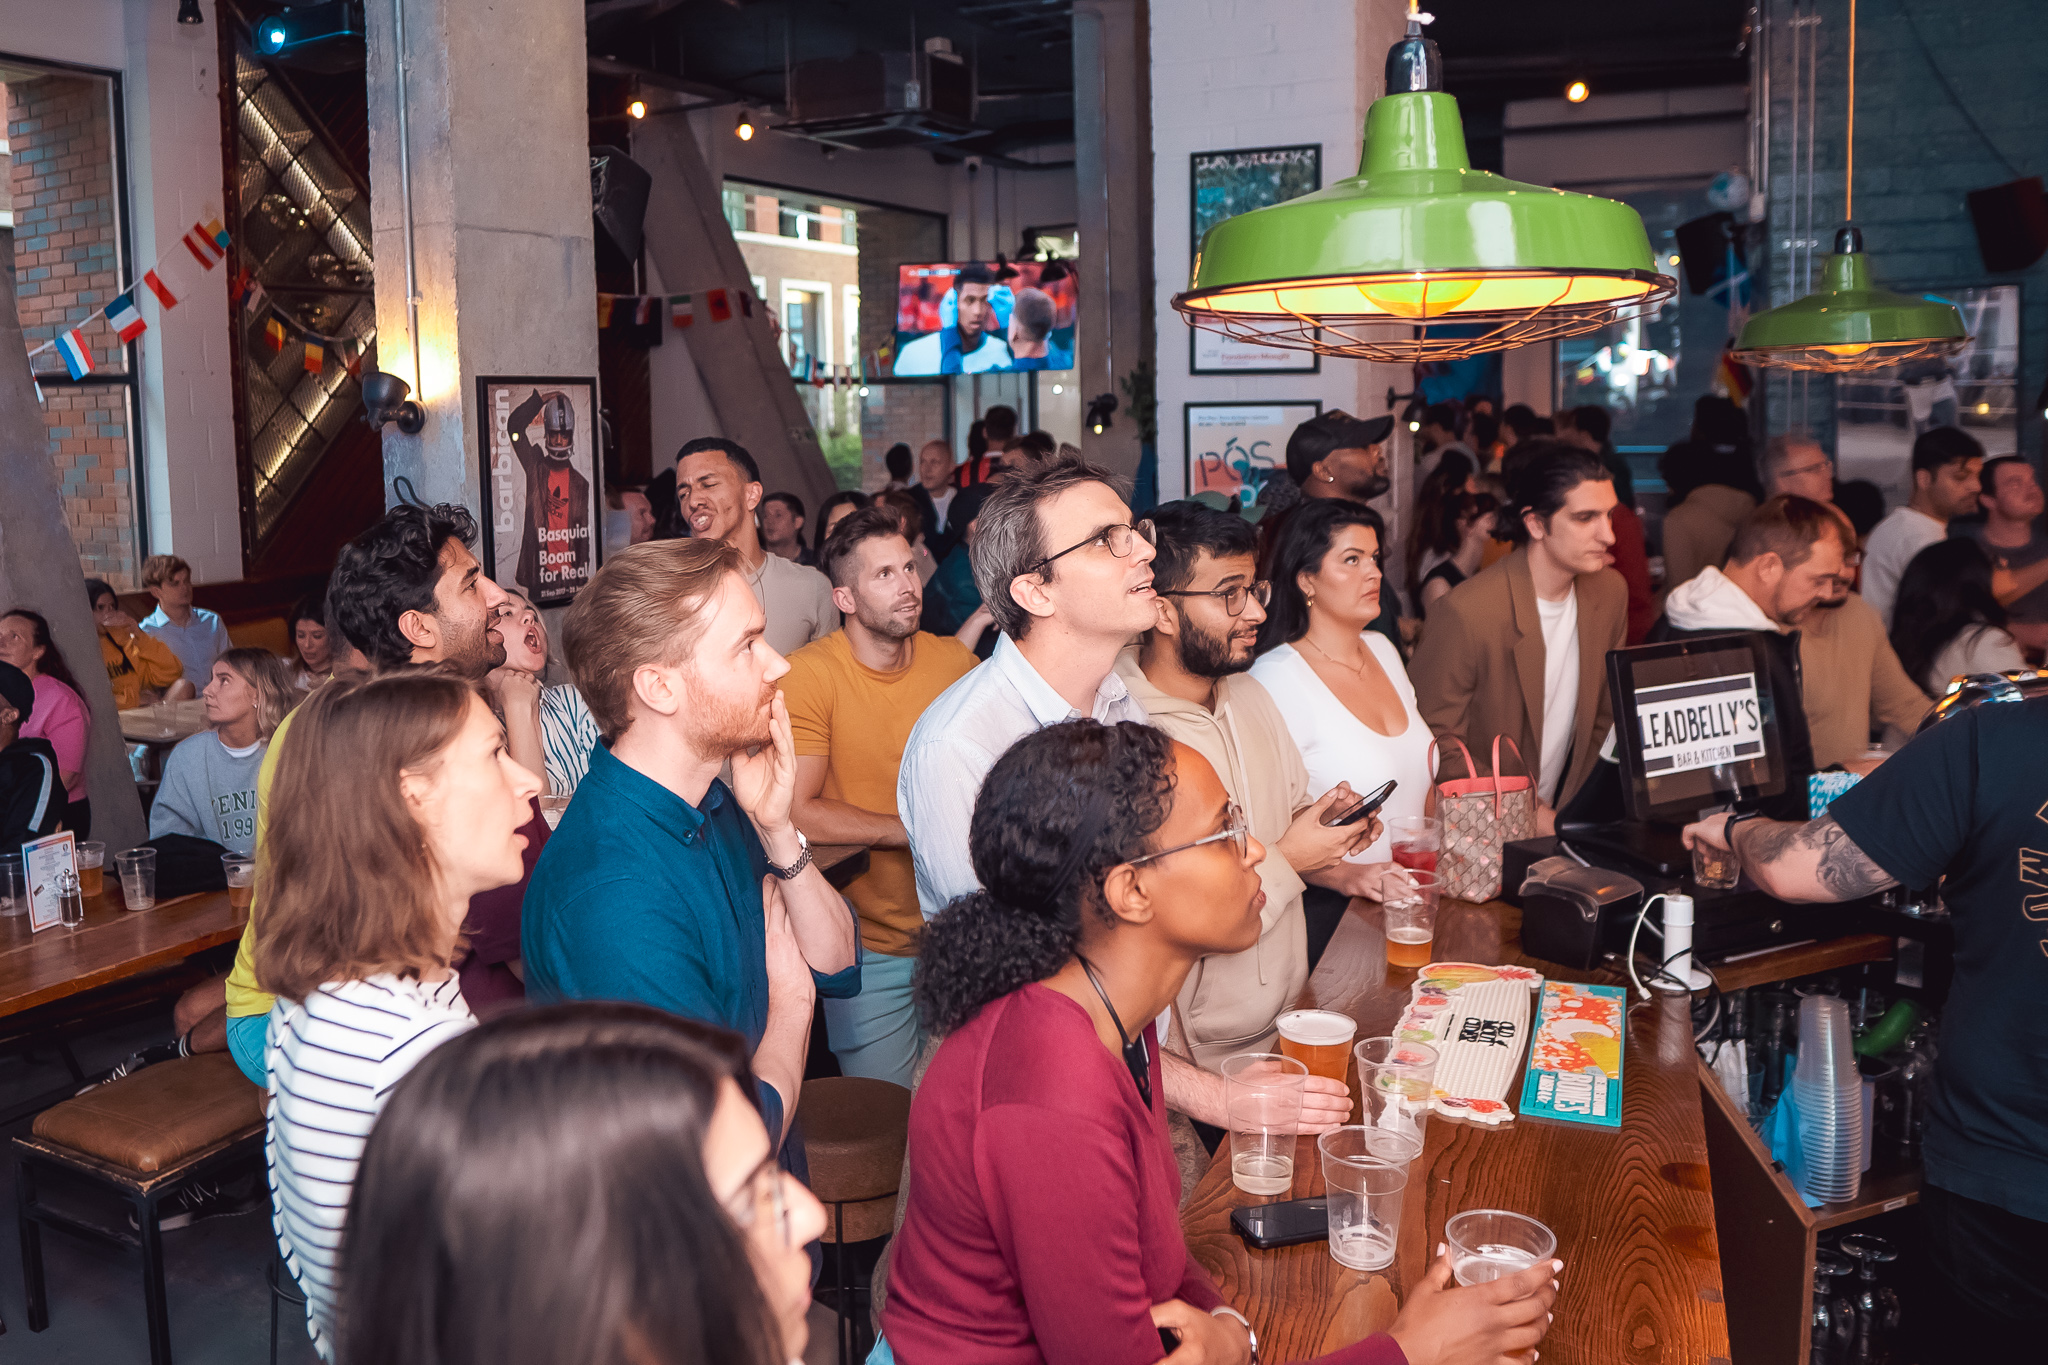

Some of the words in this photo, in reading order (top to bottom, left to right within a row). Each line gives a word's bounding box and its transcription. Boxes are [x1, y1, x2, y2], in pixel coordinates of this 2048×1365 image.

[492, 389, 515, 533] barbican
[539, 550, 576, 566] Boom
[539, 567, 559, 583] for
[561, 562, 589, 580] Real
[1638, 698, 1759, 750] LEADBELLY'S
[1677, 752, 1692, 767] BAR
[1694, 751, 1700, 765] &
[1702, 744, 1732, 762] KITCHEN
[1498, 1021, 1516, 1038] OLD
[1554, 1072, 1594, 1115] BONES
